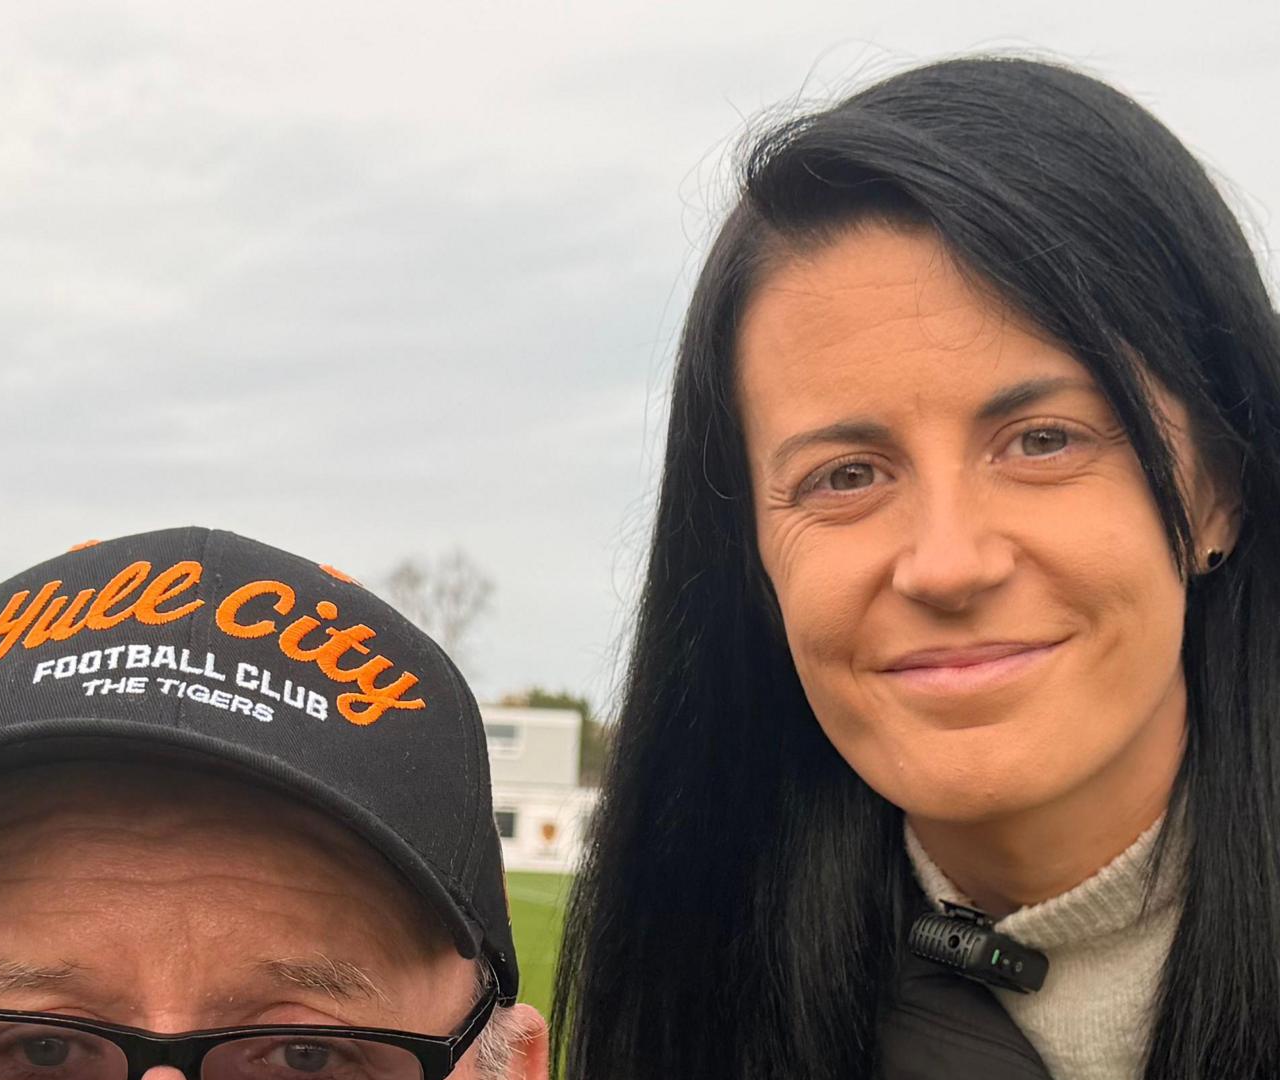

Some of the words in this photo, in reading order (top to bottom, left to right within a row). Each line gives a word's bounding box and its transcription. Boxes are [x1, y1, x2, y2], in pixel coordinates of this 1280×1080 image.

[31, 643, 226, 685] FOOTBALL
[235, 662, 329, 722] CLUB
[216, 580, 425, 726] City
[81, 676, 150, 697] THE
[156, 676, 275, 723] TIGERS
